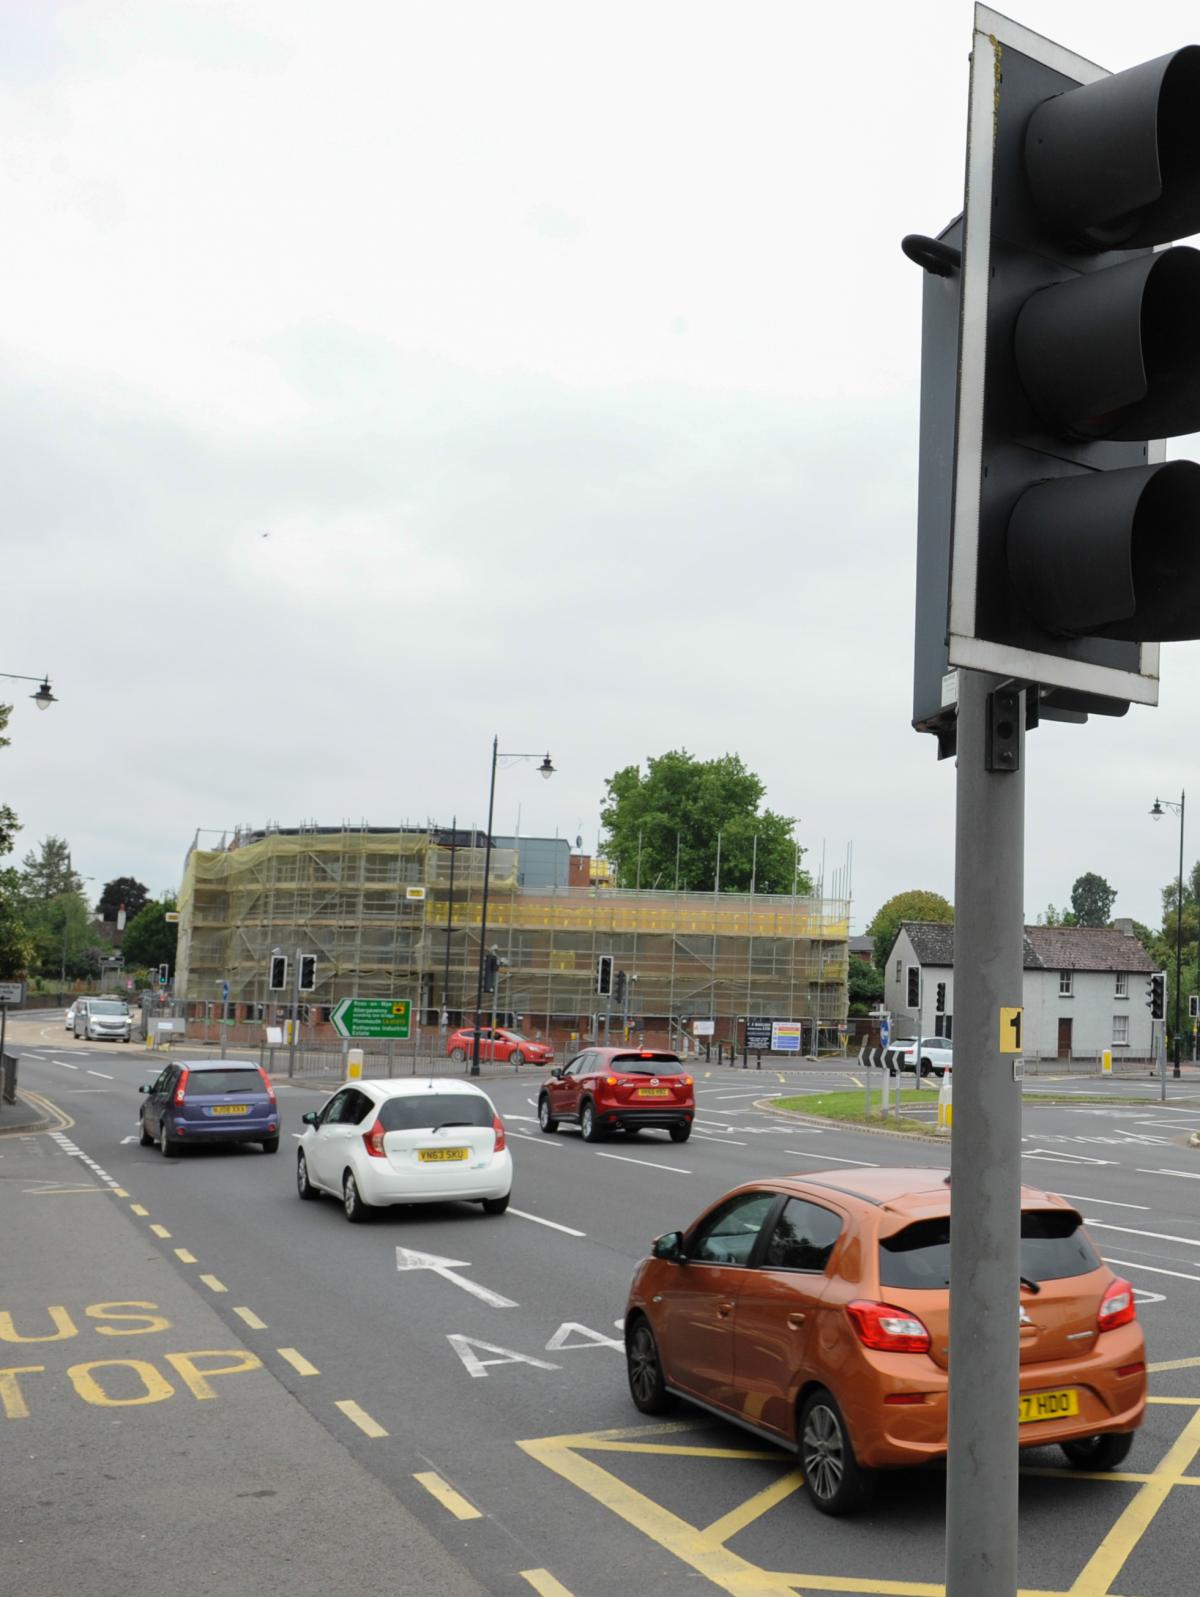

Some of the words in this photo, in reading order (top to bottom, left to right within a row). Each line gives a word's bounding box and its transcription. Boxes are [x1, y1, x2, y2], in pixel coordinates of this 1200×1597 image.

[420, 1150, 444, 1160] VN63
[447, 1149, 464, 1159] SKU
[445, 1318, 626, 1378] A4
